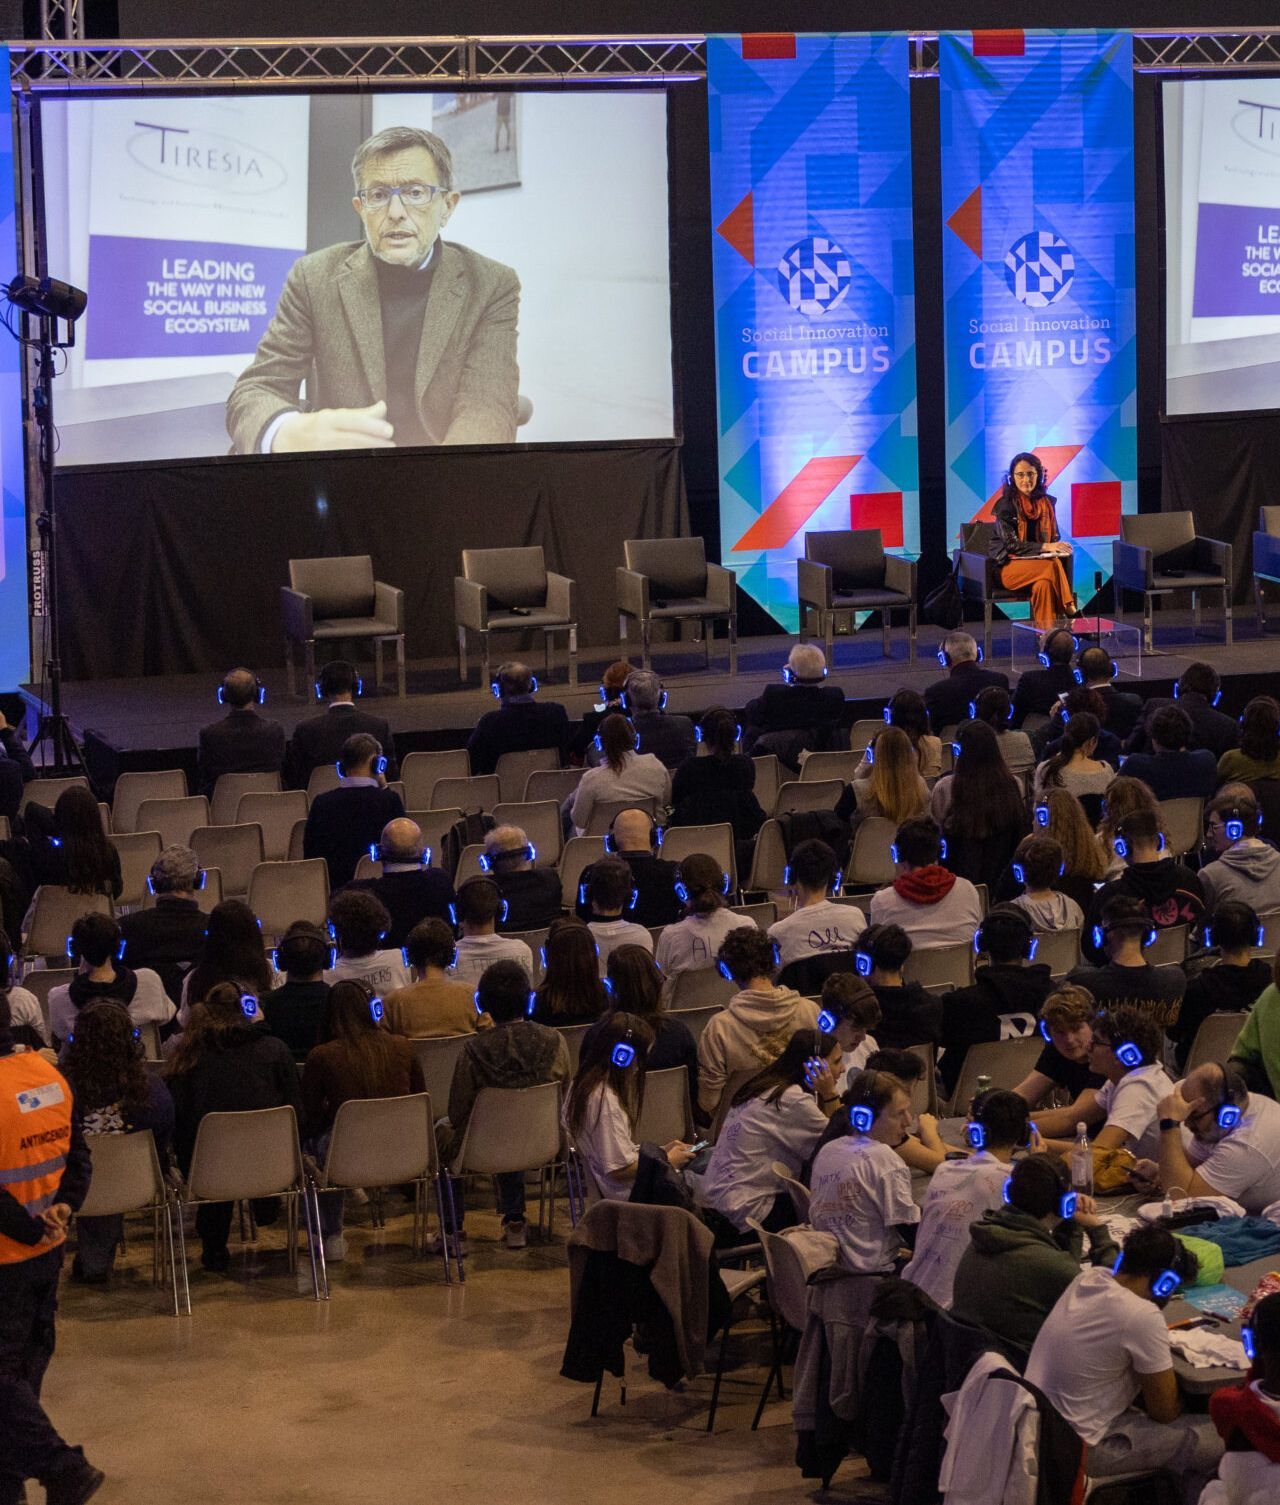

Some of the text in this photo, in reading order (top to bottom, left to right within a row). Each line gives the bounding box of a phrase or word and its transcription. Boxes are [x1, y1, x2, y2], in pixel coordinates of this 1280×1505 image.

[1245, 246, 1271, 260] THE
[162, 258, 255, 282] LEADING
[147, 281, 266, 299] THE WAY IN NEW
[143, 299, 268, 316] SOCIAL BUSINESS
[165, 318, 250, 334] ECOSYSTEM
[742, 322, 889, 343] Social Innovation
[969, 314, 1111, 334] Social Innovation
[742, 345, 890, 379] CAMPUS
[969, 337, 1111, 369] CAMPUS
[32, 550, 42, 617] PROTRUSS
